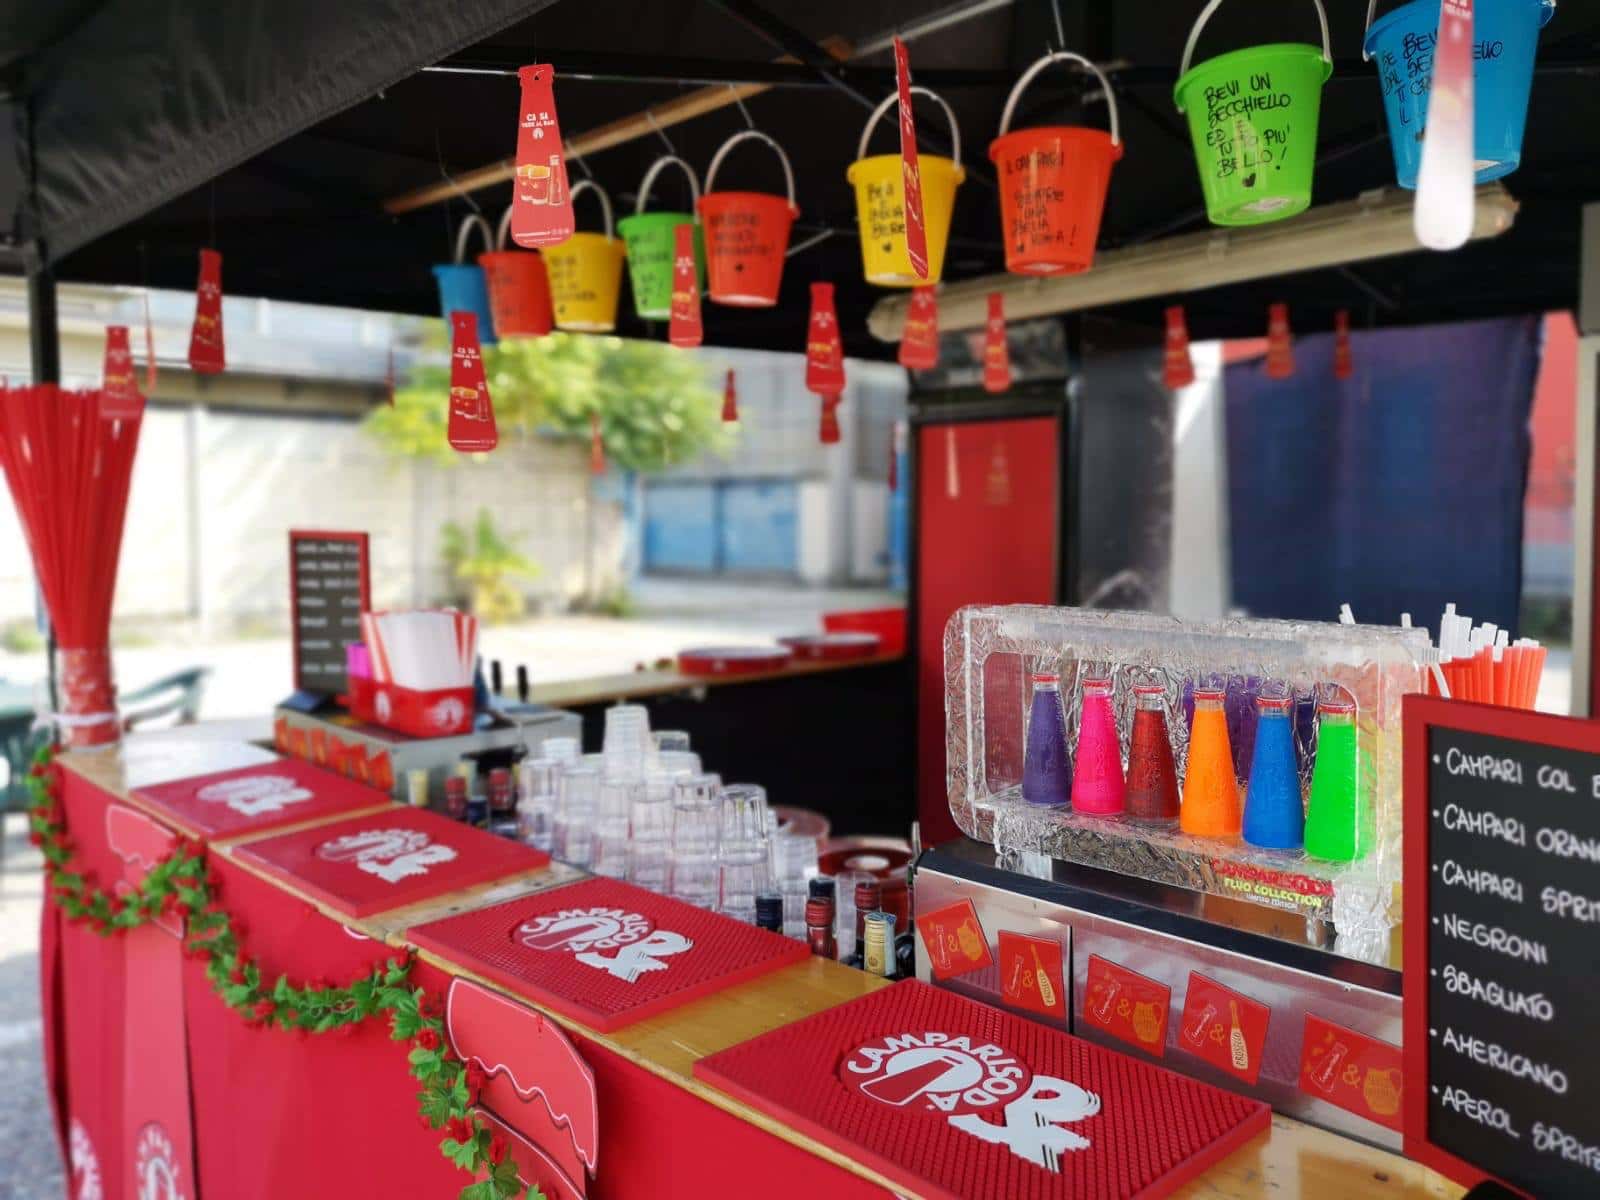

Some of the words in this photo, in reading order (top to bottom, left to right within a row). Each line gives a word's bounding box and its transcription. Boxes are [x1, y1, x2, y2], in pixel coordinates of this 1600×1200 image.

[1403, 27, 1439, 60] BEV
[1204, 79, 1241, 110] BEVI
[1250, 72, 1272, 92] UN
[1208, 94, 1292, 129] SECCHIELLO
[1446, 747, 1523, 785] CAMPARI
[1537, 765, 1576, 793] COL
[1443, 803, 1526, 847] CAMPARI
[1254, 885, 1323, 908] COLLECTION
[1442, 860, 1524, 903] CAMPARI
[1443, 913, 1548, 965] NEGRONI
[1443, 964, 1554, 1021] SBAGLIATO
[1442, 1027, 1568, 1094] AMERICANO
[1442, 1085, 1521, 1138] APEROL
